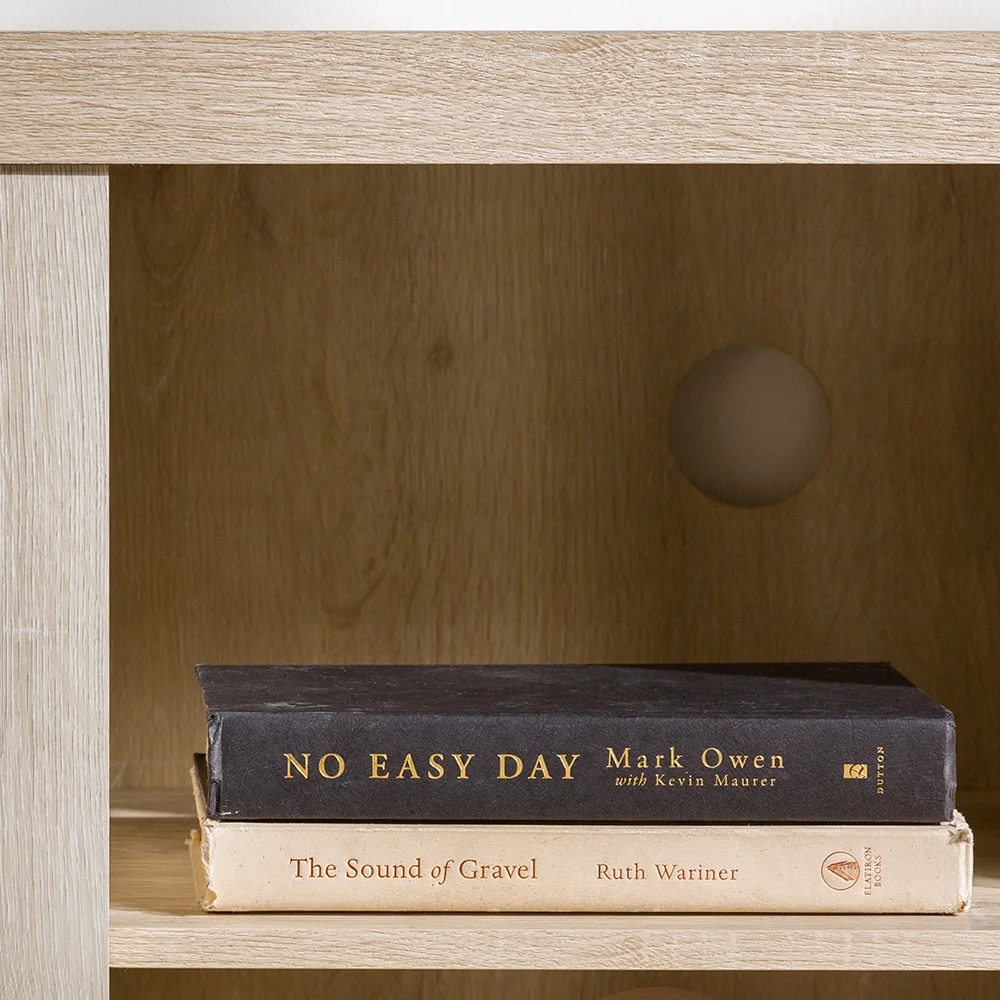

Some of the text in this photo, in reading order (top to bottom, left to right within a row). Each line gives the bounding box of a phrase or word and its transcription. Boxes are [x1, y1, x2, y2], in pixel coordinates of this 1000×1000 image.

[284, 752, 582, 781] NO EASY DAY
[605, 746, 785, 769] Mark Owen
[876, 746, 885, 795] DUTTON
[614, 772, 777, 787] with Kevin Maurer
[289, 857, 538, 886] The Sound of Gravel
[596, 862, 740, 881] Ruth Wariner
[863, 846, 872, 896] FLATIRON
[873, 855, 882, 887] BOOKS
